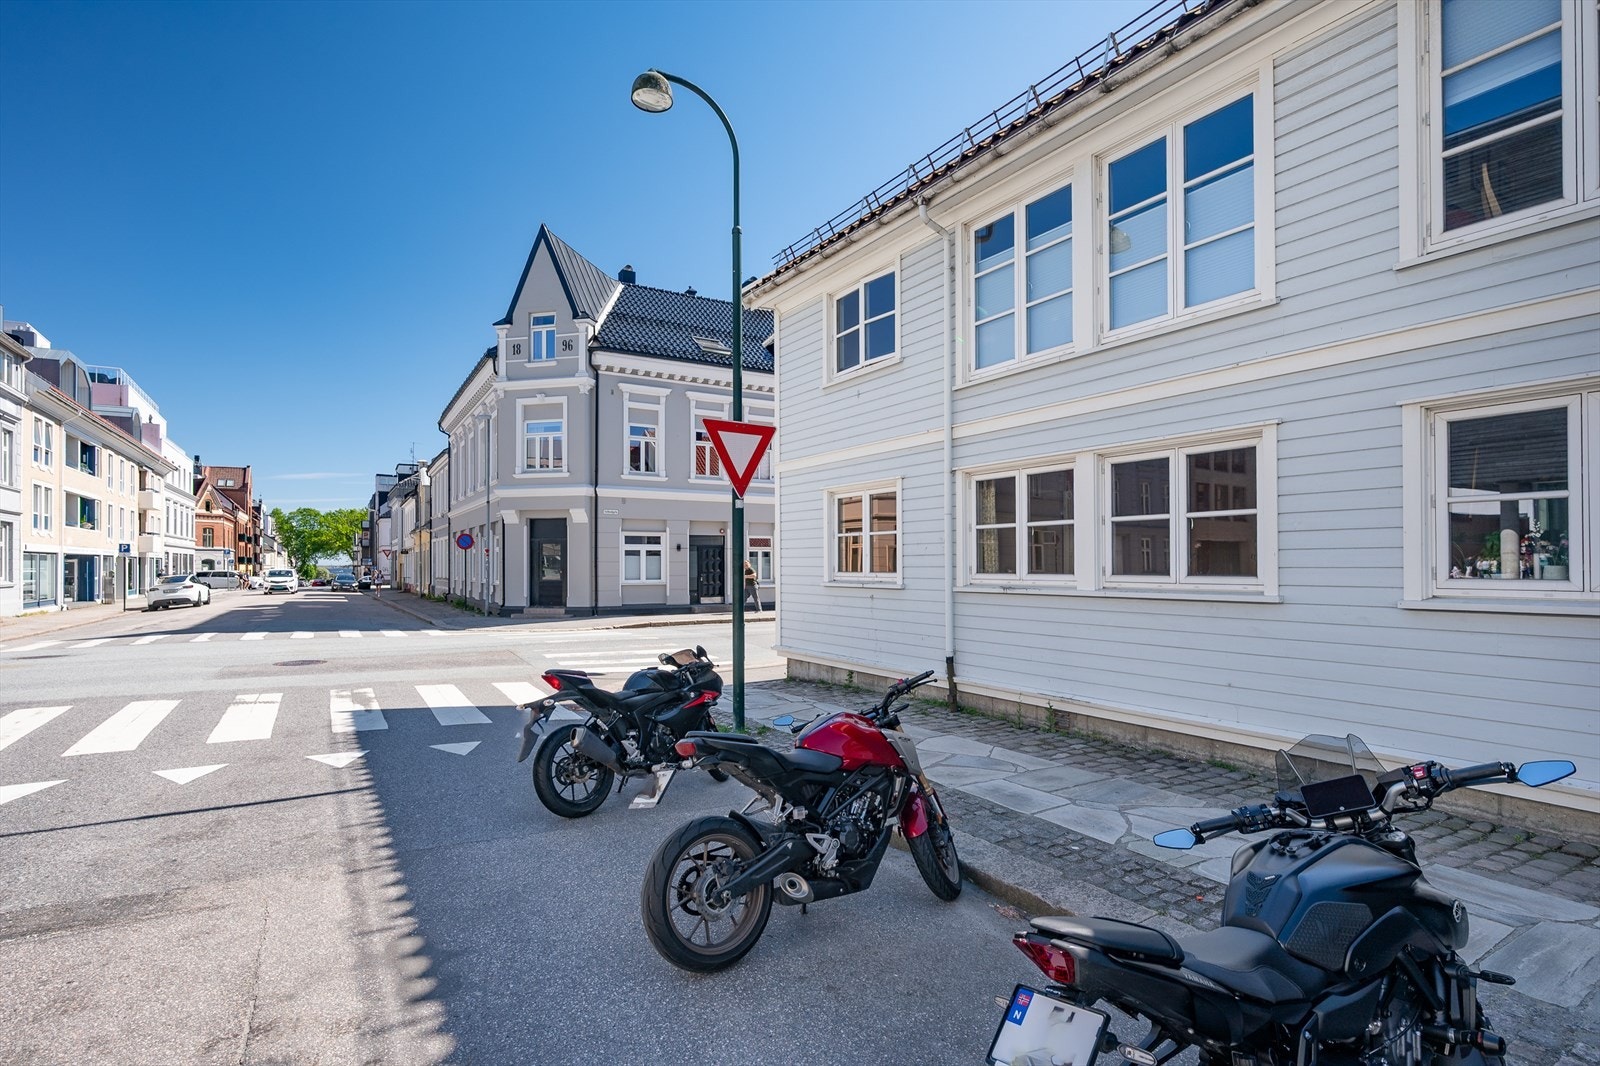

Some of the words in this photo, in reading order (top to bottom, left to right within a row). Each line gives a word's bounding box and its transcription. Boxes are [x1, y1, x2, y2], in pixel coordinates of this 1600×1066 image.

[512, 343, 521, 355] 18
[562, 339, 573, 351] 96
[1182, 971, 1216, 989] YAMAHA
[1013, 1010, 1022, 1020] N
